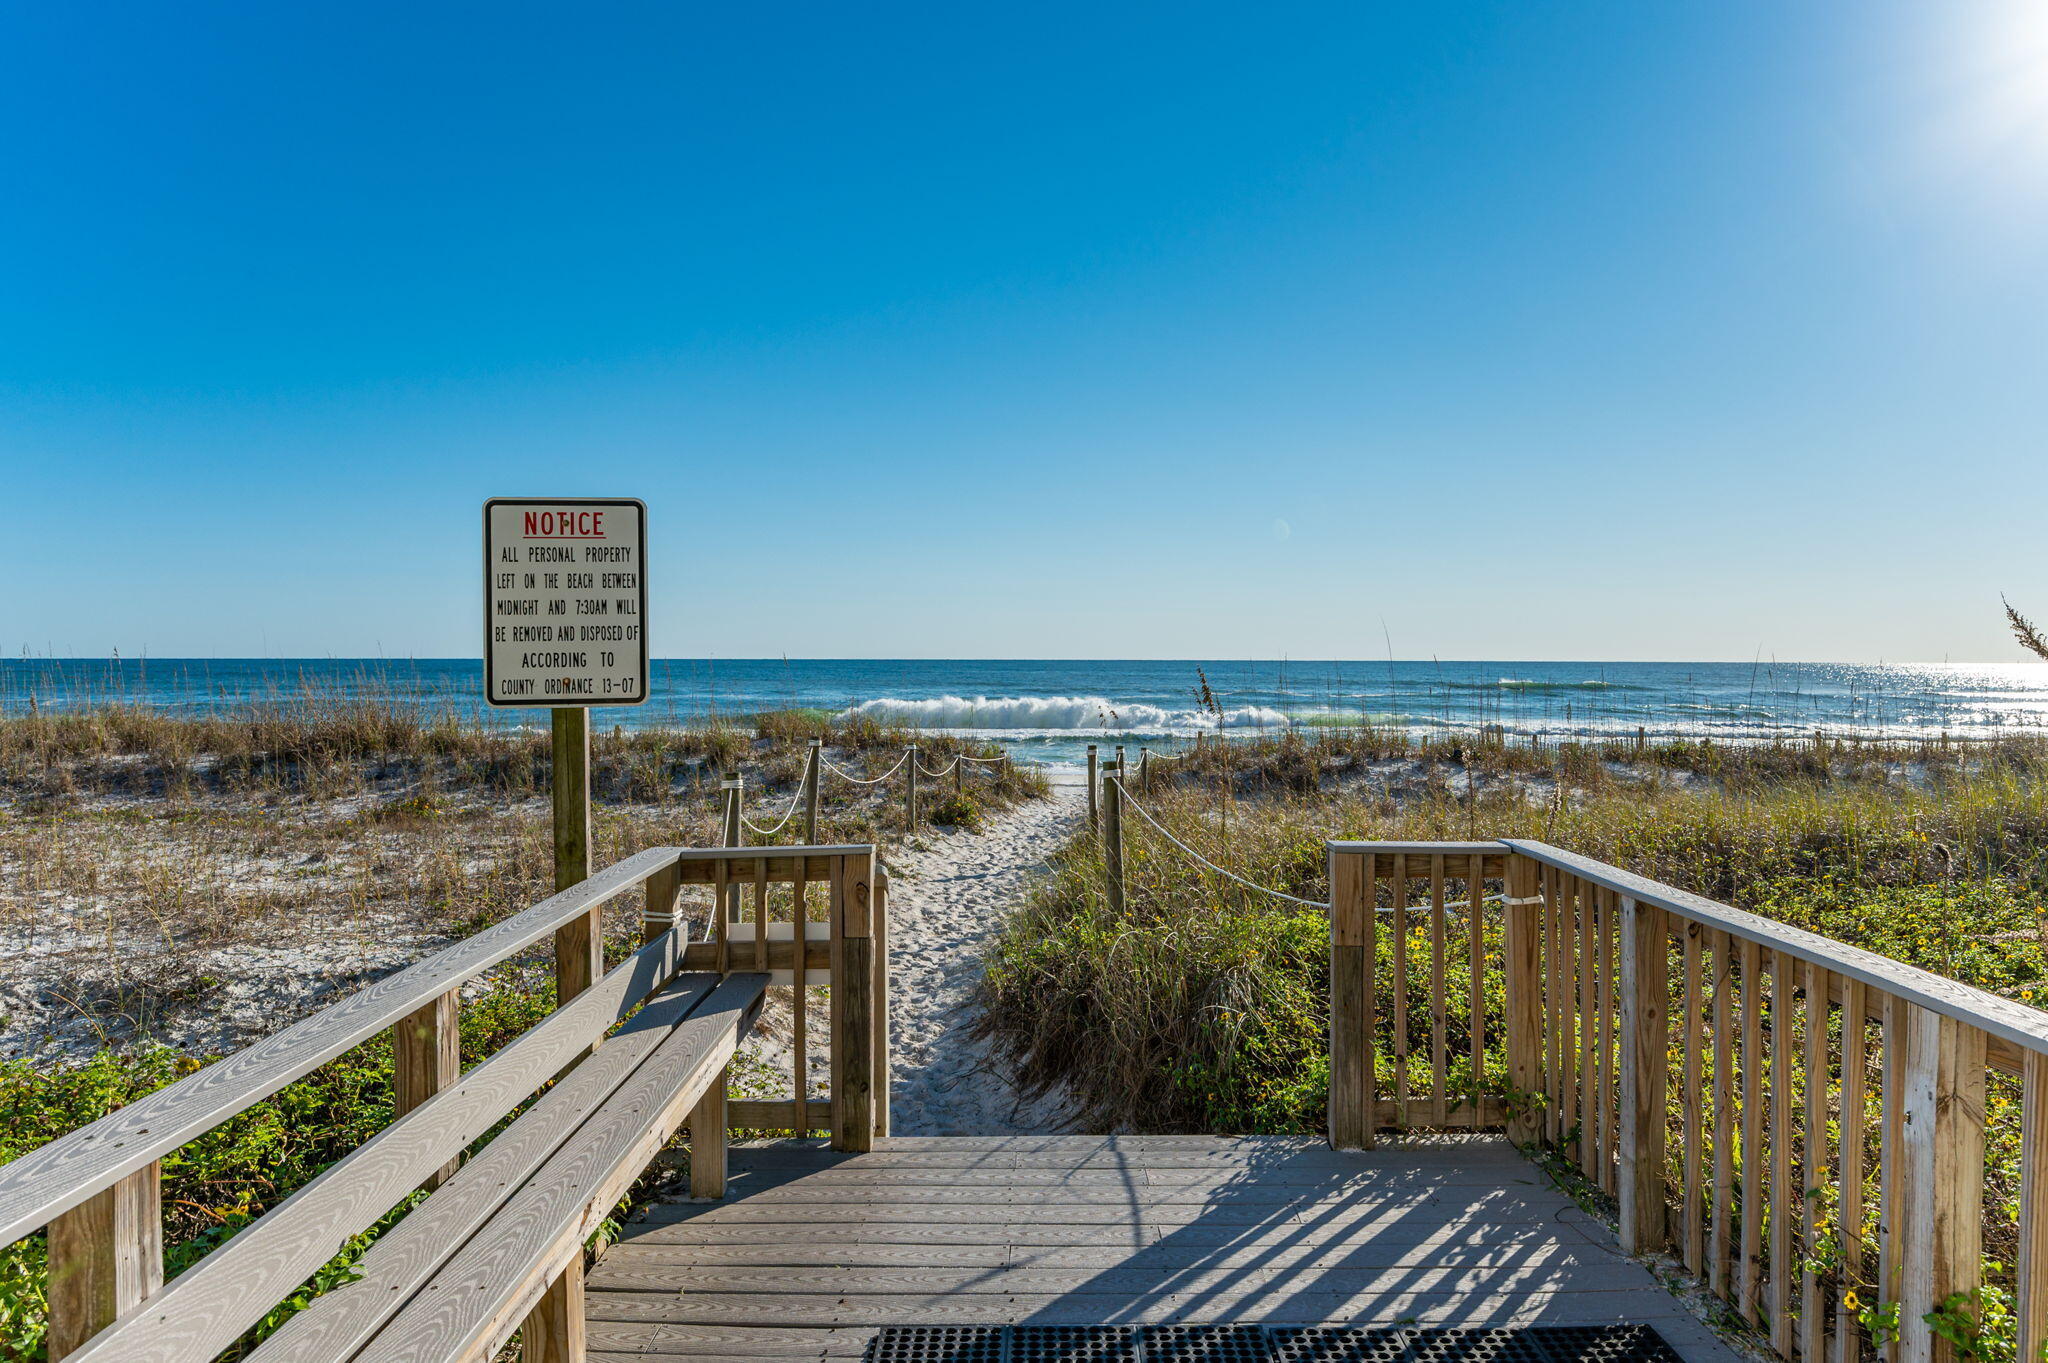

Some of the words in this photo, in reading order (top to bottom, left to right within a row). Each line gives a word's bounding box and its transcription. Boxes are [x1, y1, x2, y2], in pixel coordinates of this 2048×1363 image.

[524, 512, 604, 535] NOTICE
[502, 547, 518, 562] ALL
[529, 547, 575, 562] PERSONAL
[586, 547, 631, 562] PROPERTY
[497, 574, 515, 588] LEFT
[524, 574, 535, 588] ON
[544, 574, 558, 588] THE
[568, 574, 593, 588] BEACH
[602, 574, 636, 588] BETWEEN
[497, 600, 538, 615] MIDNIGHT
[549, 600, 566, 615] AND
[576, 600, 607, 615] 7:30AM
[617, 600, 636, 614] WILL
[496, 627, 506, 642] BE
[513, 627, 552, 641] REMOVED
[558, 626, 574, 641] AND
[581, 626, 622, 641] DISPOSED
[627, 626, 639, 640] OF
[522, 653, 586, 668] ACCORDING
[601, 652, 614, 667] TO
[502, 679, 534, 694] COUNTY
[603, 678, 634, 693] 13-07
